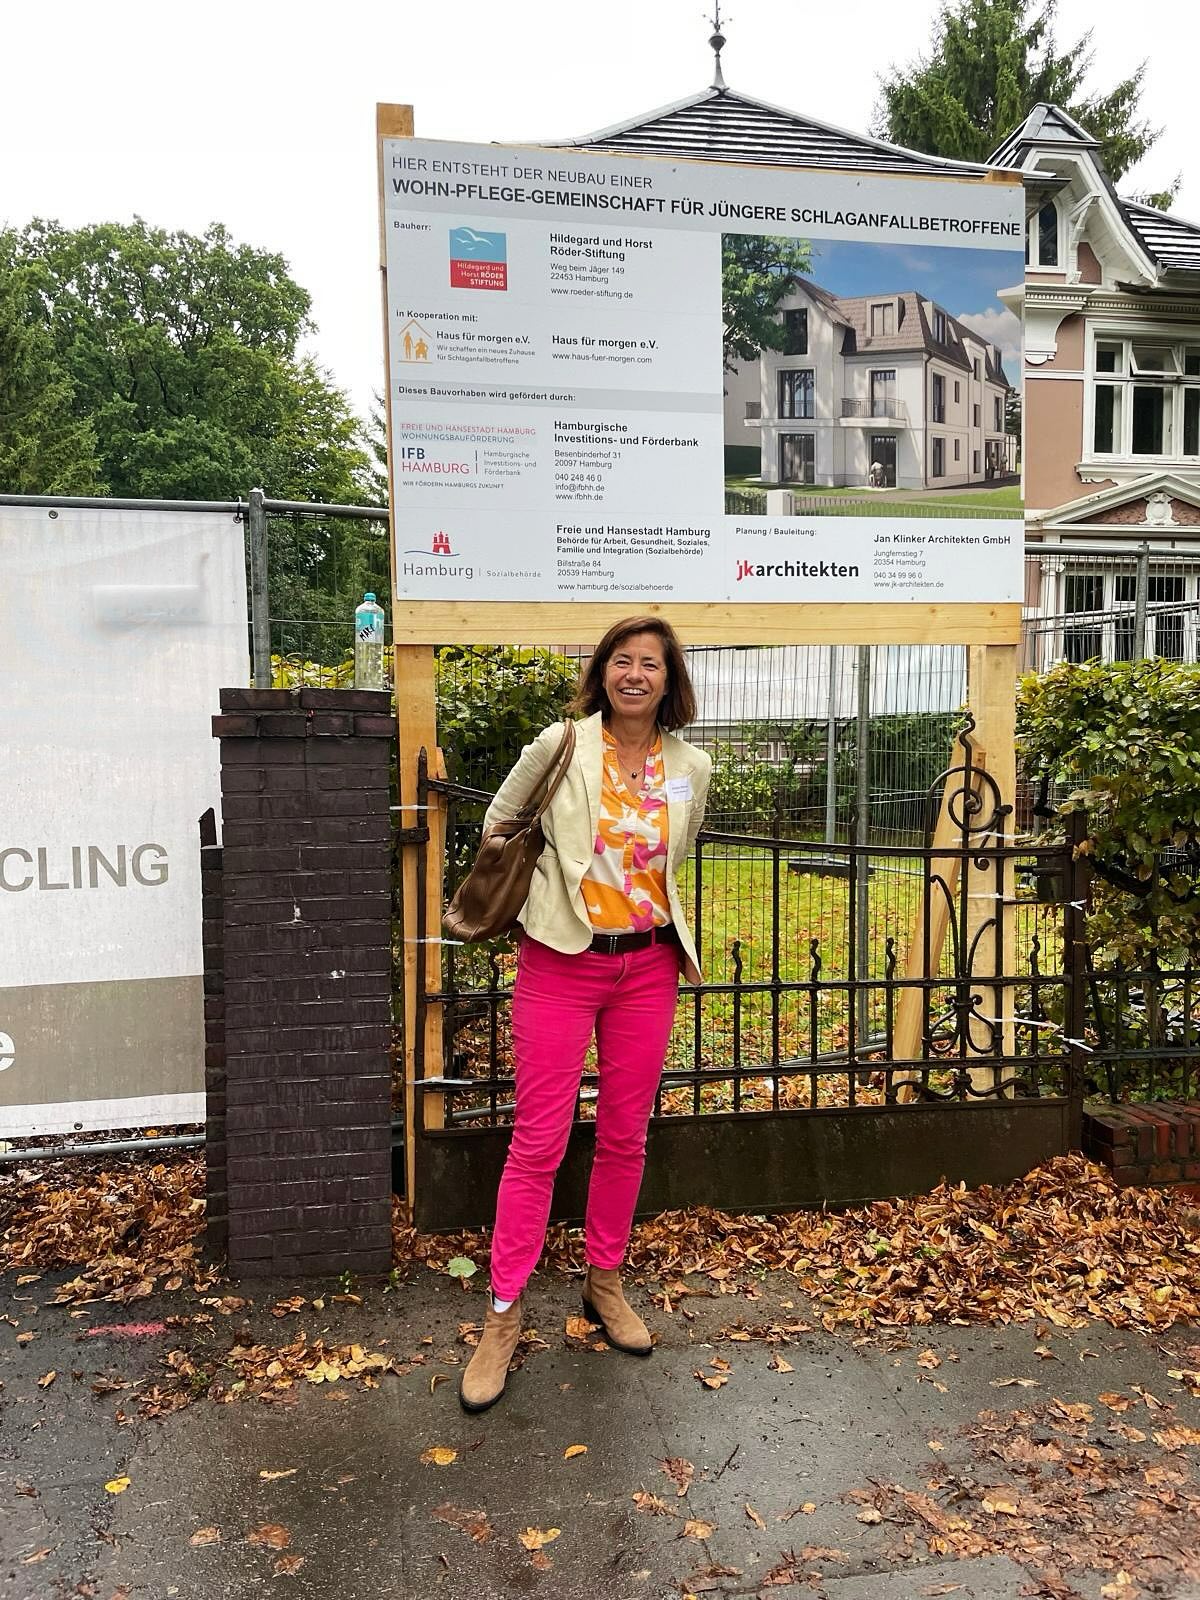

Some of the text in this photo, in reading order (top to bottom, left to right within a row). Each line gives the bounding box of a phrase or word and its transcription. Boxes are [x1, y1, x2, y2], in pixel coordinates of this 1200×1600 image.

[393, 157, 652, 188] HIER ENTSTEHT DER NEUBAU EINER
[392, 178, 1020, 236] WOHN-PFLEGE-GEMEINSCHAFT FÜR JÜNGERE SCHLAGANFALLBETROFFENE
[394, 221, 431, 231] Bauherr:
[550, 233, 652, 248] Hildegard und Horst
[550, 246, 625, 261] Röder-Stiftung
[457, 262, 490, 272] Hildegard
[550, 263, 567, 272] Weg
[589, 266, 609, 274] Jäger
[480, 271, 503, 279] RÖDER
[576, 274, 608, 284] Hamburg
[470, 278, 504, 286] STIFTUNG
[551, 288, 633, 299] www.roeder-stiftung.de
[407, 310, 459, 321] Kooperation
[436, 331, 530, 344] Haus für morgen e.V.
[552, 335, 658, 349] Haus für morgen e.V.
[509, 348, 535, 356] Zuhause
[552, 353, 652, 364] www.haus-fuer-morgen.com
[398, 386, 427, 395] Dieses
[430, 388, 486, 397] Bauvorhaben
[510, 392, 547, 400] gefördert
[550, 393, 576, 401] durch:
[554, 420, 628, 433] Hamburgische
[401, 433, 514, 443] WOHNUNGSBAUFÖRDERUNG
[554, 434, 698, 447] Investitions- und Förderbank
[401, 447, 425, 459] IFB
[484, 450, 530, 459] Hamburgische
[554, 450, 610, 458] Besenbinderhof
[402, 462, 469, 474] HAMBURG
[580, 460, 612, 469] Hamburg
[555, 483, 604, 492] info@ifbhh.de
[556, 525, 711, 538] Freie und Hansestadt Hamburg
[735, 528, 767, 536] Planung
[774, 528, 816, 536] Bauleitung:
[631, 538, 675, 546] Gesundheit,
[874, 535, 1010, 544] Jan Klinker Architekten GmbH
[603, 547, 643, 555] Integration
[646, 548, 704, 556] (Sozialbehörde)
[874, 550, 917, 558] Jungfernstieg
[404, 562, 473, 579] Hamburg
[582, 570, 614, 578] Hamburg
[736, 560, 859, 581] jkarchitekten
[558, 583, 673, 591] www.hamburg.de/sozialbehoerde
[0, 843, 169, 892] CLING
